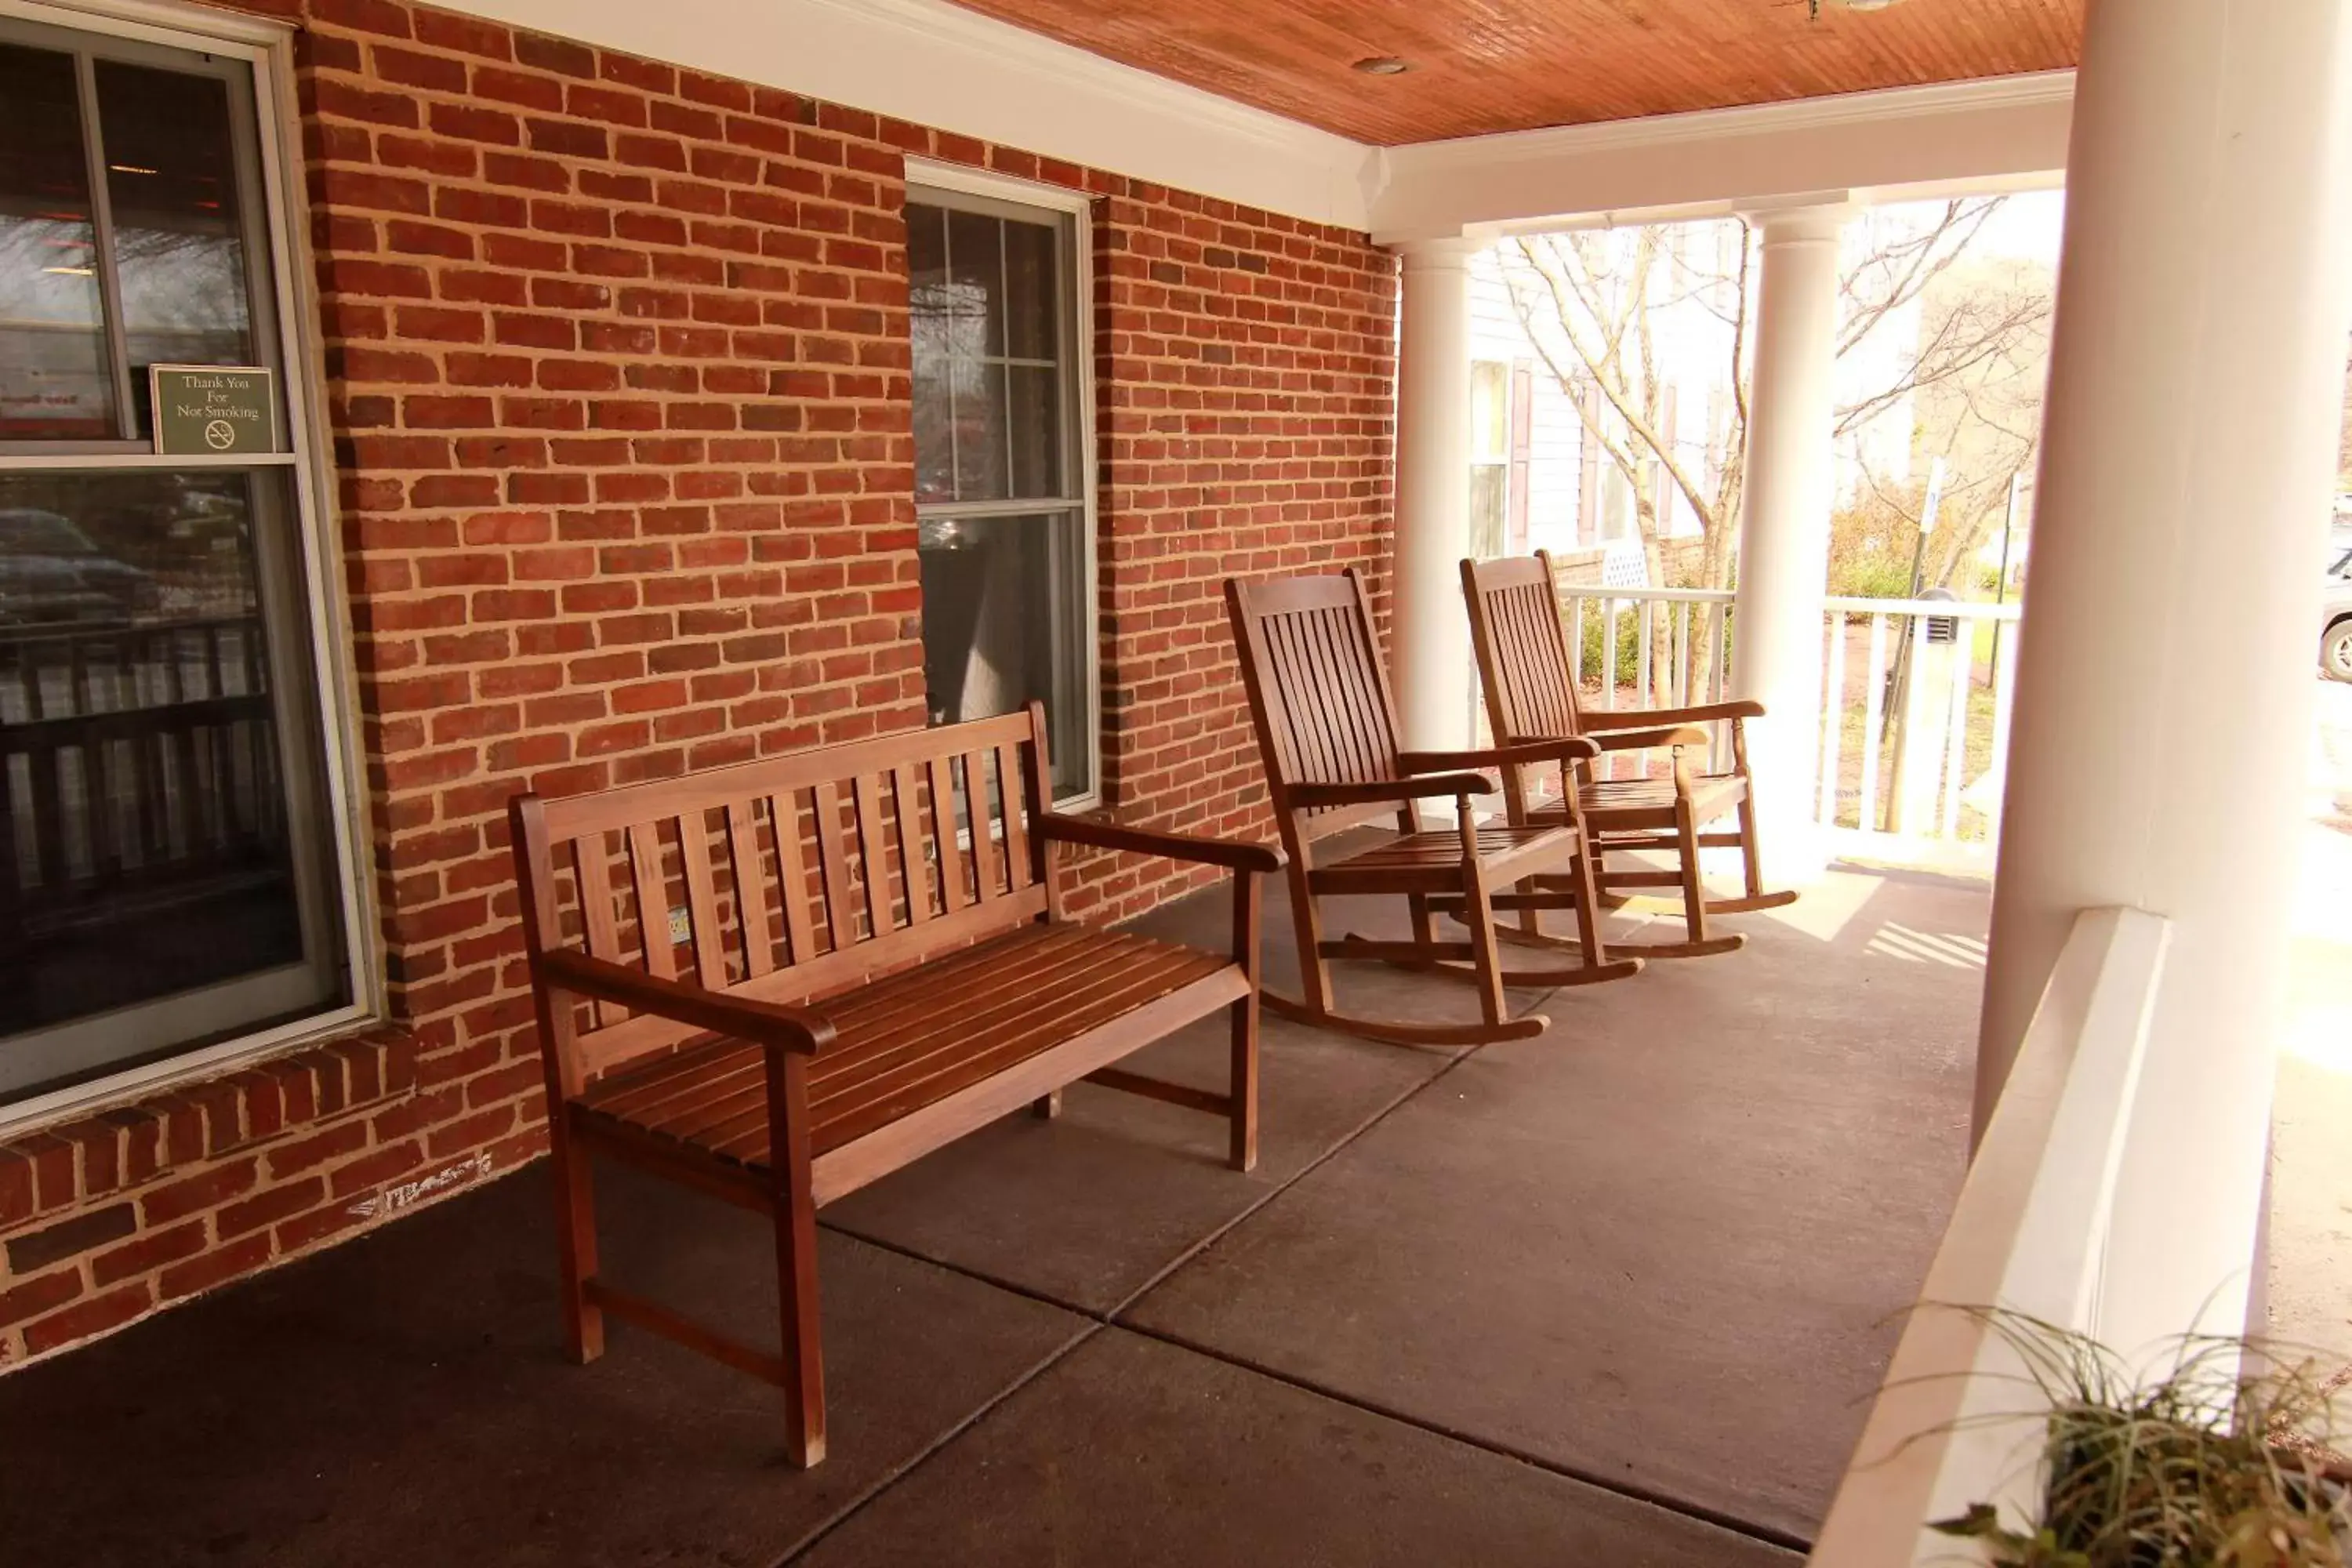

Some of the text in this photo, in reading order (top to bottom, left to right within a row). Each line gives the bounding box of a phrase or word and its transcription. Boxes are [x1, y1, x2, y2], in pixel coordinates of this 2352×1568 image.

[182, 376, 250, 390] Thank You
[207, 390, 230, 402] For
[176, 404, 260, 421] Not Smoking
